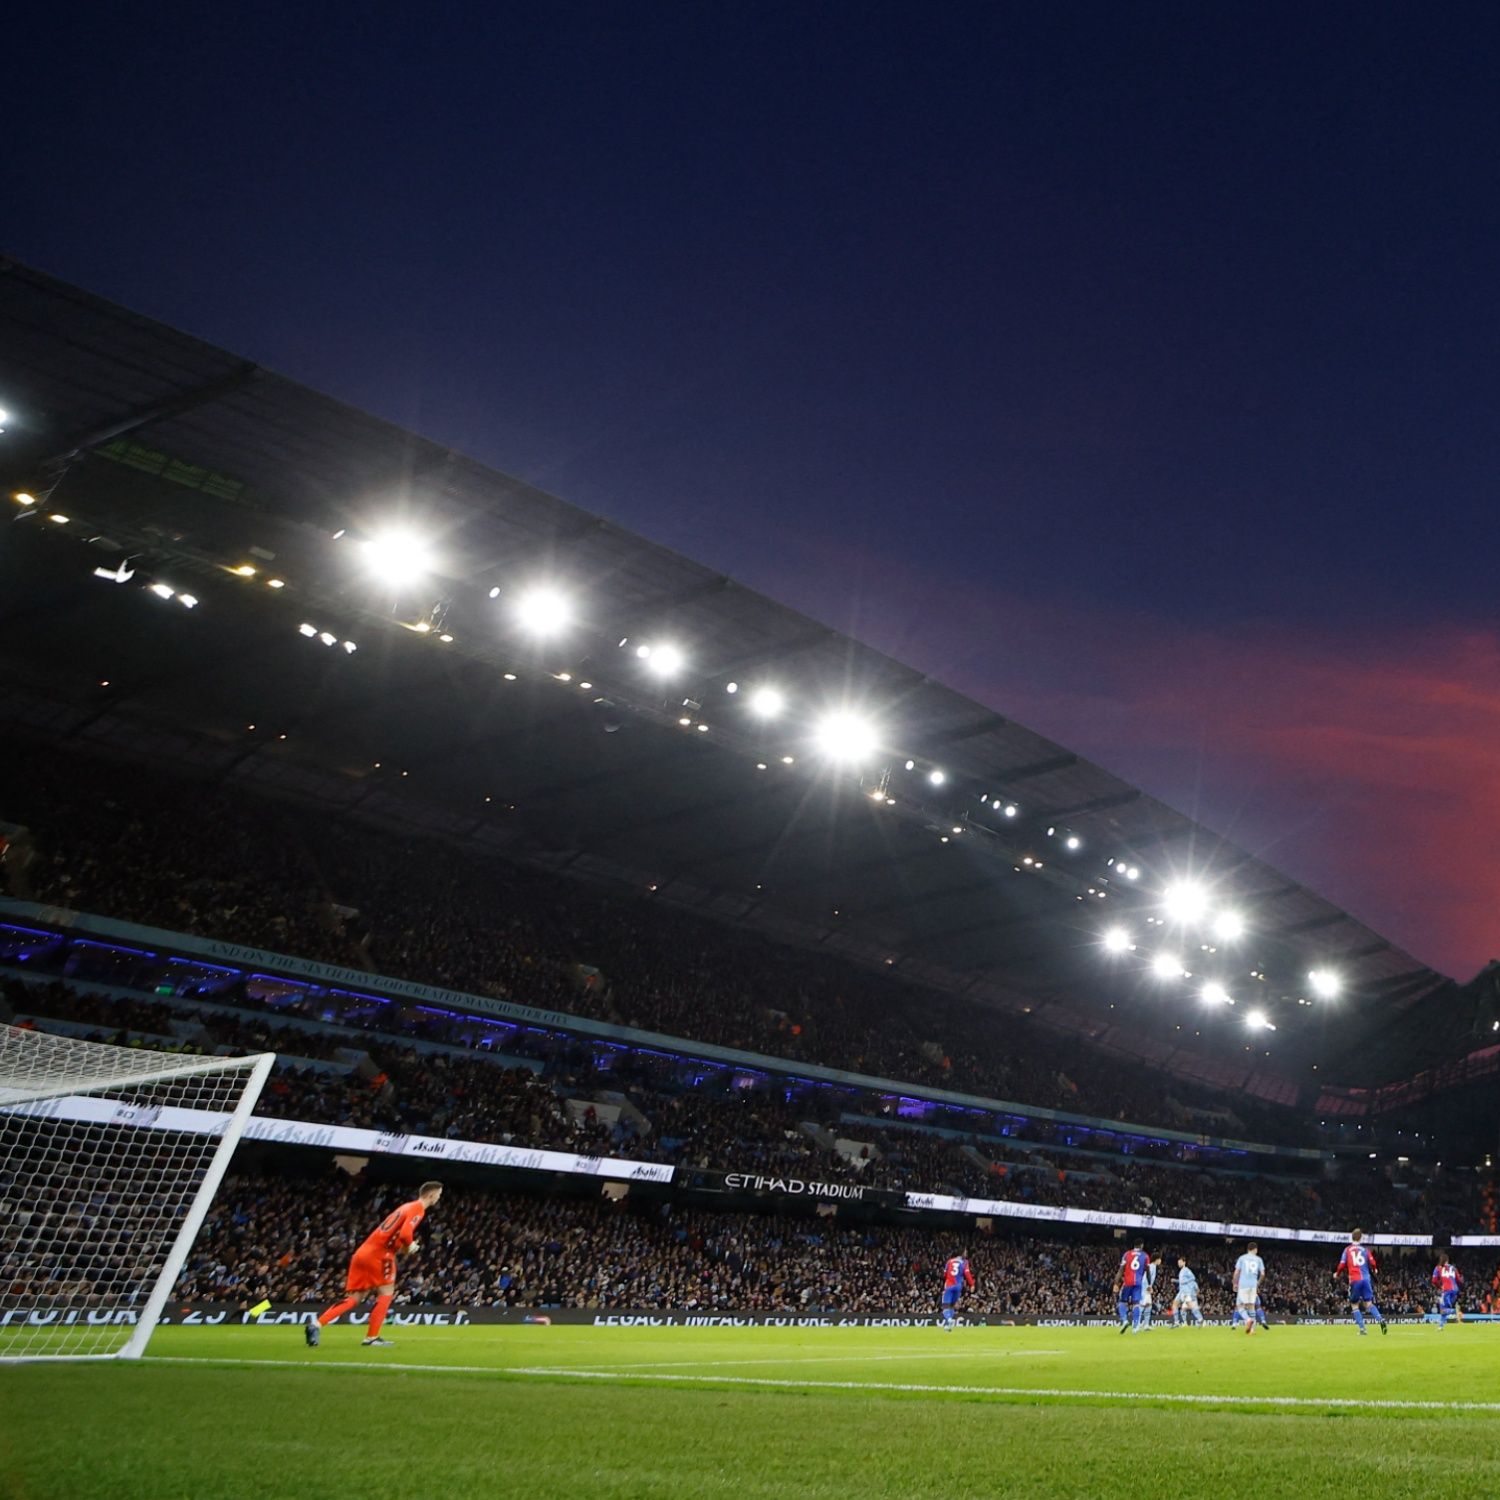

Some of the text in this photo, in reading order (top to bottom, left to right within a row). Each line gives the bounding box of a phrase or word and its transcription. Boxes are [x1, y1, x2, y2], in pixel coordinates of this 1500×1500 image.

[210, 942, 241, 958] AND
[242, 948, 264, 963] ON
[269, 953, 295, 969] THE
[405, 982, 462, 1002] CREATED
[464, 996, 542, 1020] MANCHESTER
[544, 1010, 568, 1024] CITY
[210, 1118, 336, 1147] Aahi Asahi
[413, 1140, 446, 1153] Asahi
[447, 1144, 544, 1169] Asahi Asahi
[724, 1173, 864, 1200] ETIHAD STADIUM
[1130, 1255, 1140, 1271] 6
[1350, 1250, 1365, 1266] 16
[950, 1262, 960, 1276] 3
[1245, 1260, 1258, 1273] 19
[1441, 1263, 1456, 1278] 44
[0, 1310, 171, 1325] FUTUR.
[242, 1311, 339, 1325] EAR
